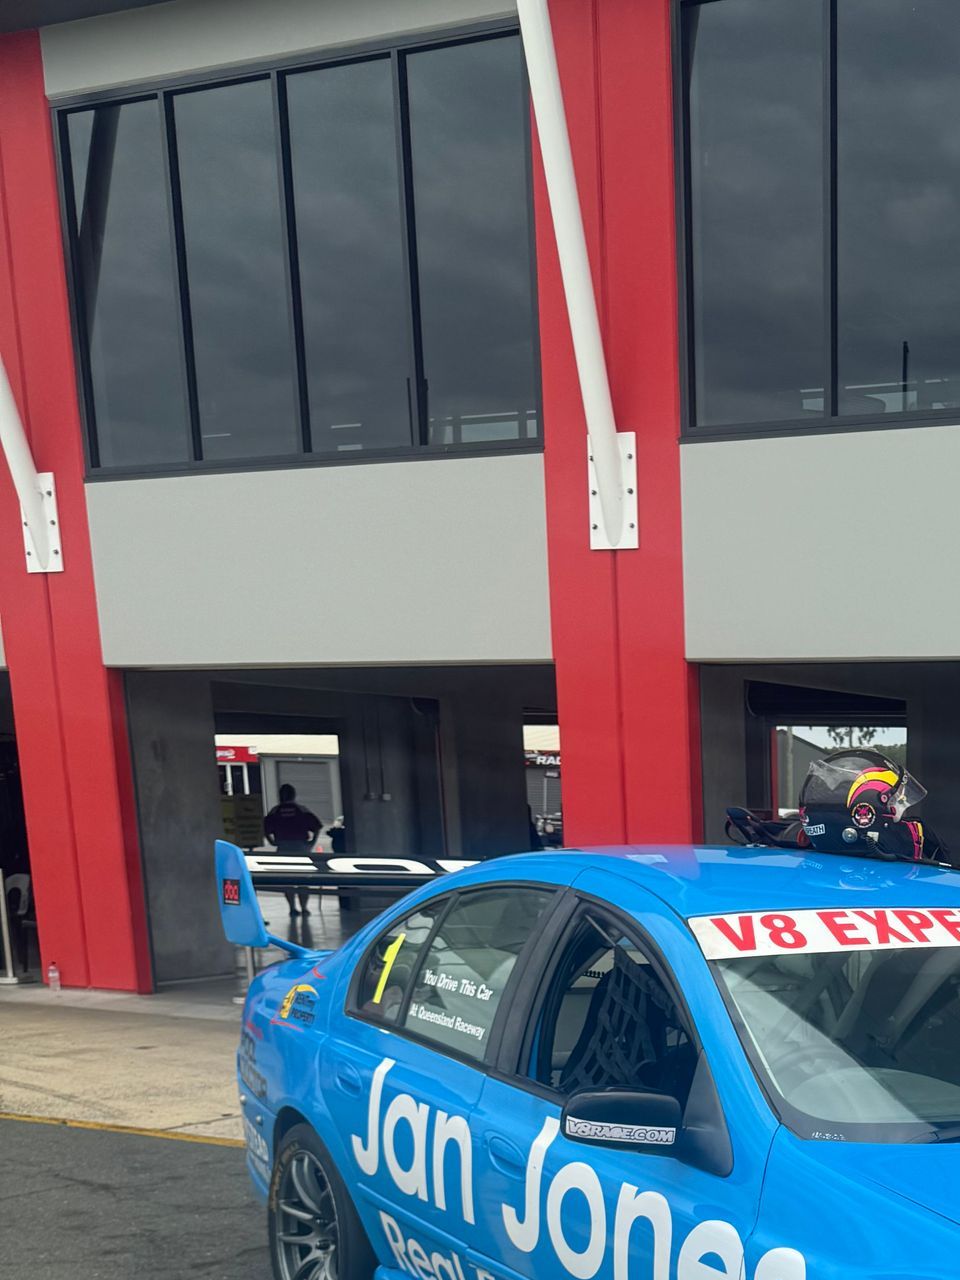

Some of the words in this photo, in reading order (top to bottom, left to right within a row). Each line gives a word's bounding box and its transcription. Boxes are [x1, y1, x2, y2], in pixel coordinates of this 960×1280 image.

[710, 914, 808, 951] V8
[373, 932, 406, 1004] 1
[424, 969, 438, 986] You
[436, 973, 458, 991] Drive
[459, 979, 476, 997] This
[477, 984, 493, 1000] Car
[409, 1003, 418, 1016] At
[418, 1006, 455, 1029] Queensland
[454, 1017, 485, 1040] Raceway
[352, 1057, 475, 1225] Jan
